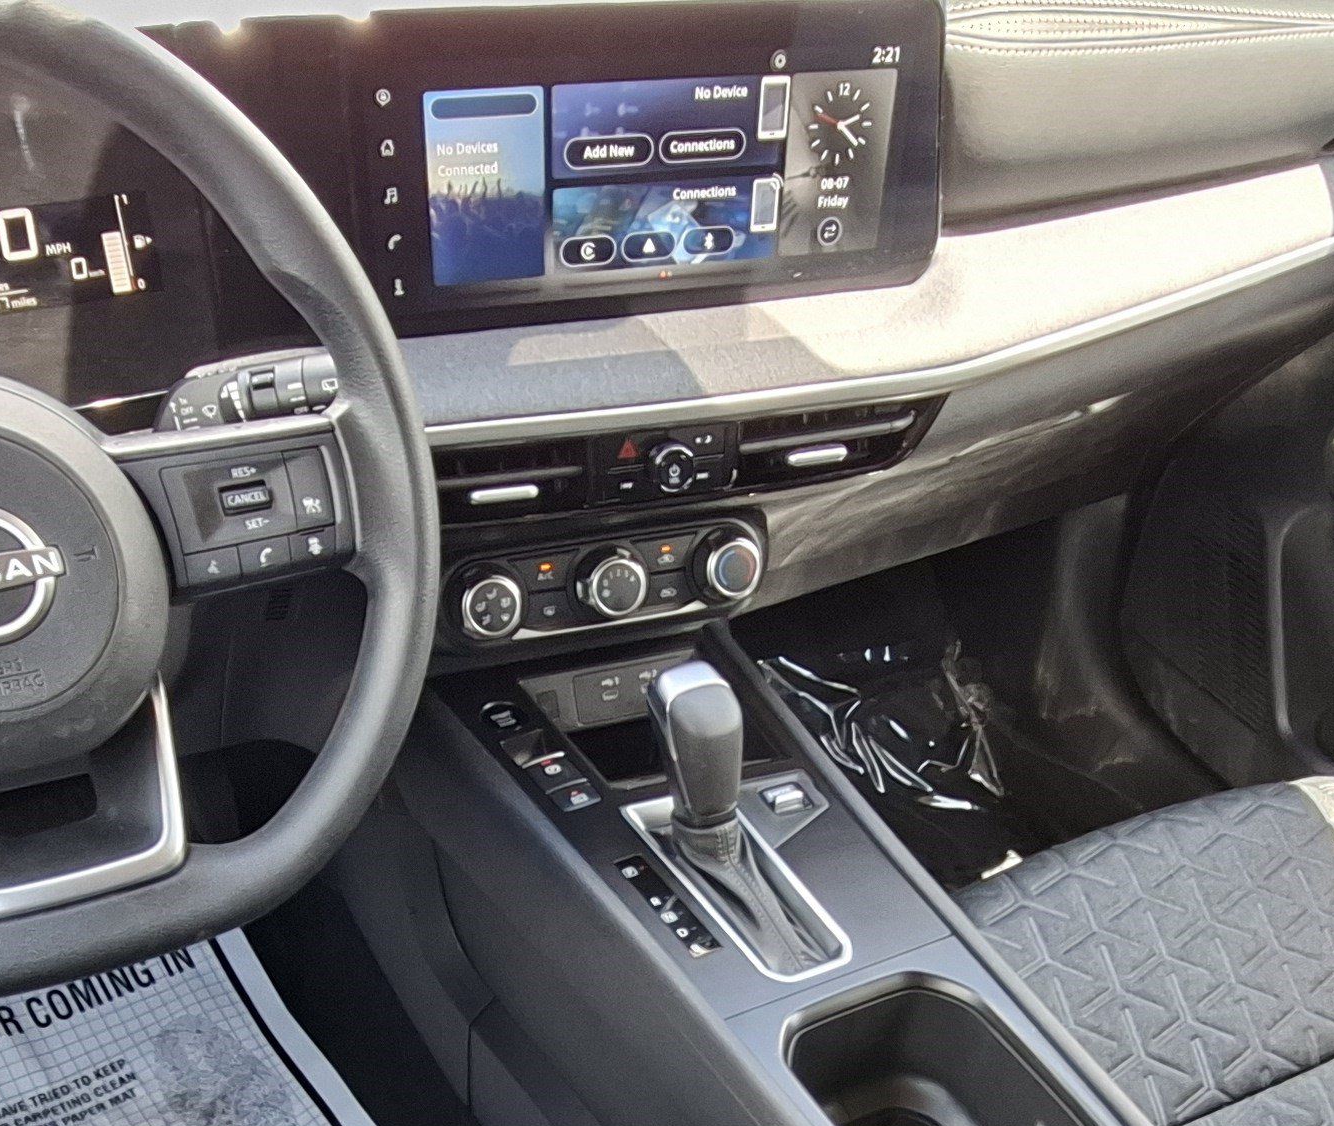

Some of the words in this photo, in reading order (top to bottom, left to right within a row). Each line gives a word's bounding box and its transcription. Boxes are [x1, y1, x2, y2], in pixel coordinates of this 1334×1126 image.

[871, 46, 901, 64] 2:21
[694, 86, 710, 100] No
[713, 84, 748, 99] Device
[838, 83, 850, 96] 12
[436, 143, 453, 156] No
[456, 141, 498, 155] Devices
[582, 145, 608, 159] Add
[609, 144, 635, 158] New
[669, 137, 735, 154] Connections
[437, 161, 498, 177] Connected
[672, 185, 737, 200] Connections
[817, 195, 850, 209] Friday
[45, 242, 72, 255] MPH
[11, 297, 38, 308] miles
[227, 491, 267, 505] CANCEL
[25, 962, 156, 1028] COMING
[160, 949, 195, 977] IN
[29, 1084, 71, 1107] TRIED
[72, 1075, 91, 1090] TO
[93, 1058, 126, 1081] KEEP
[93, 1072, 136, 1098] CLEAN
[62, 1102, 107, 1126] PAPER
[108, 1087, 138, 1107] MAT
